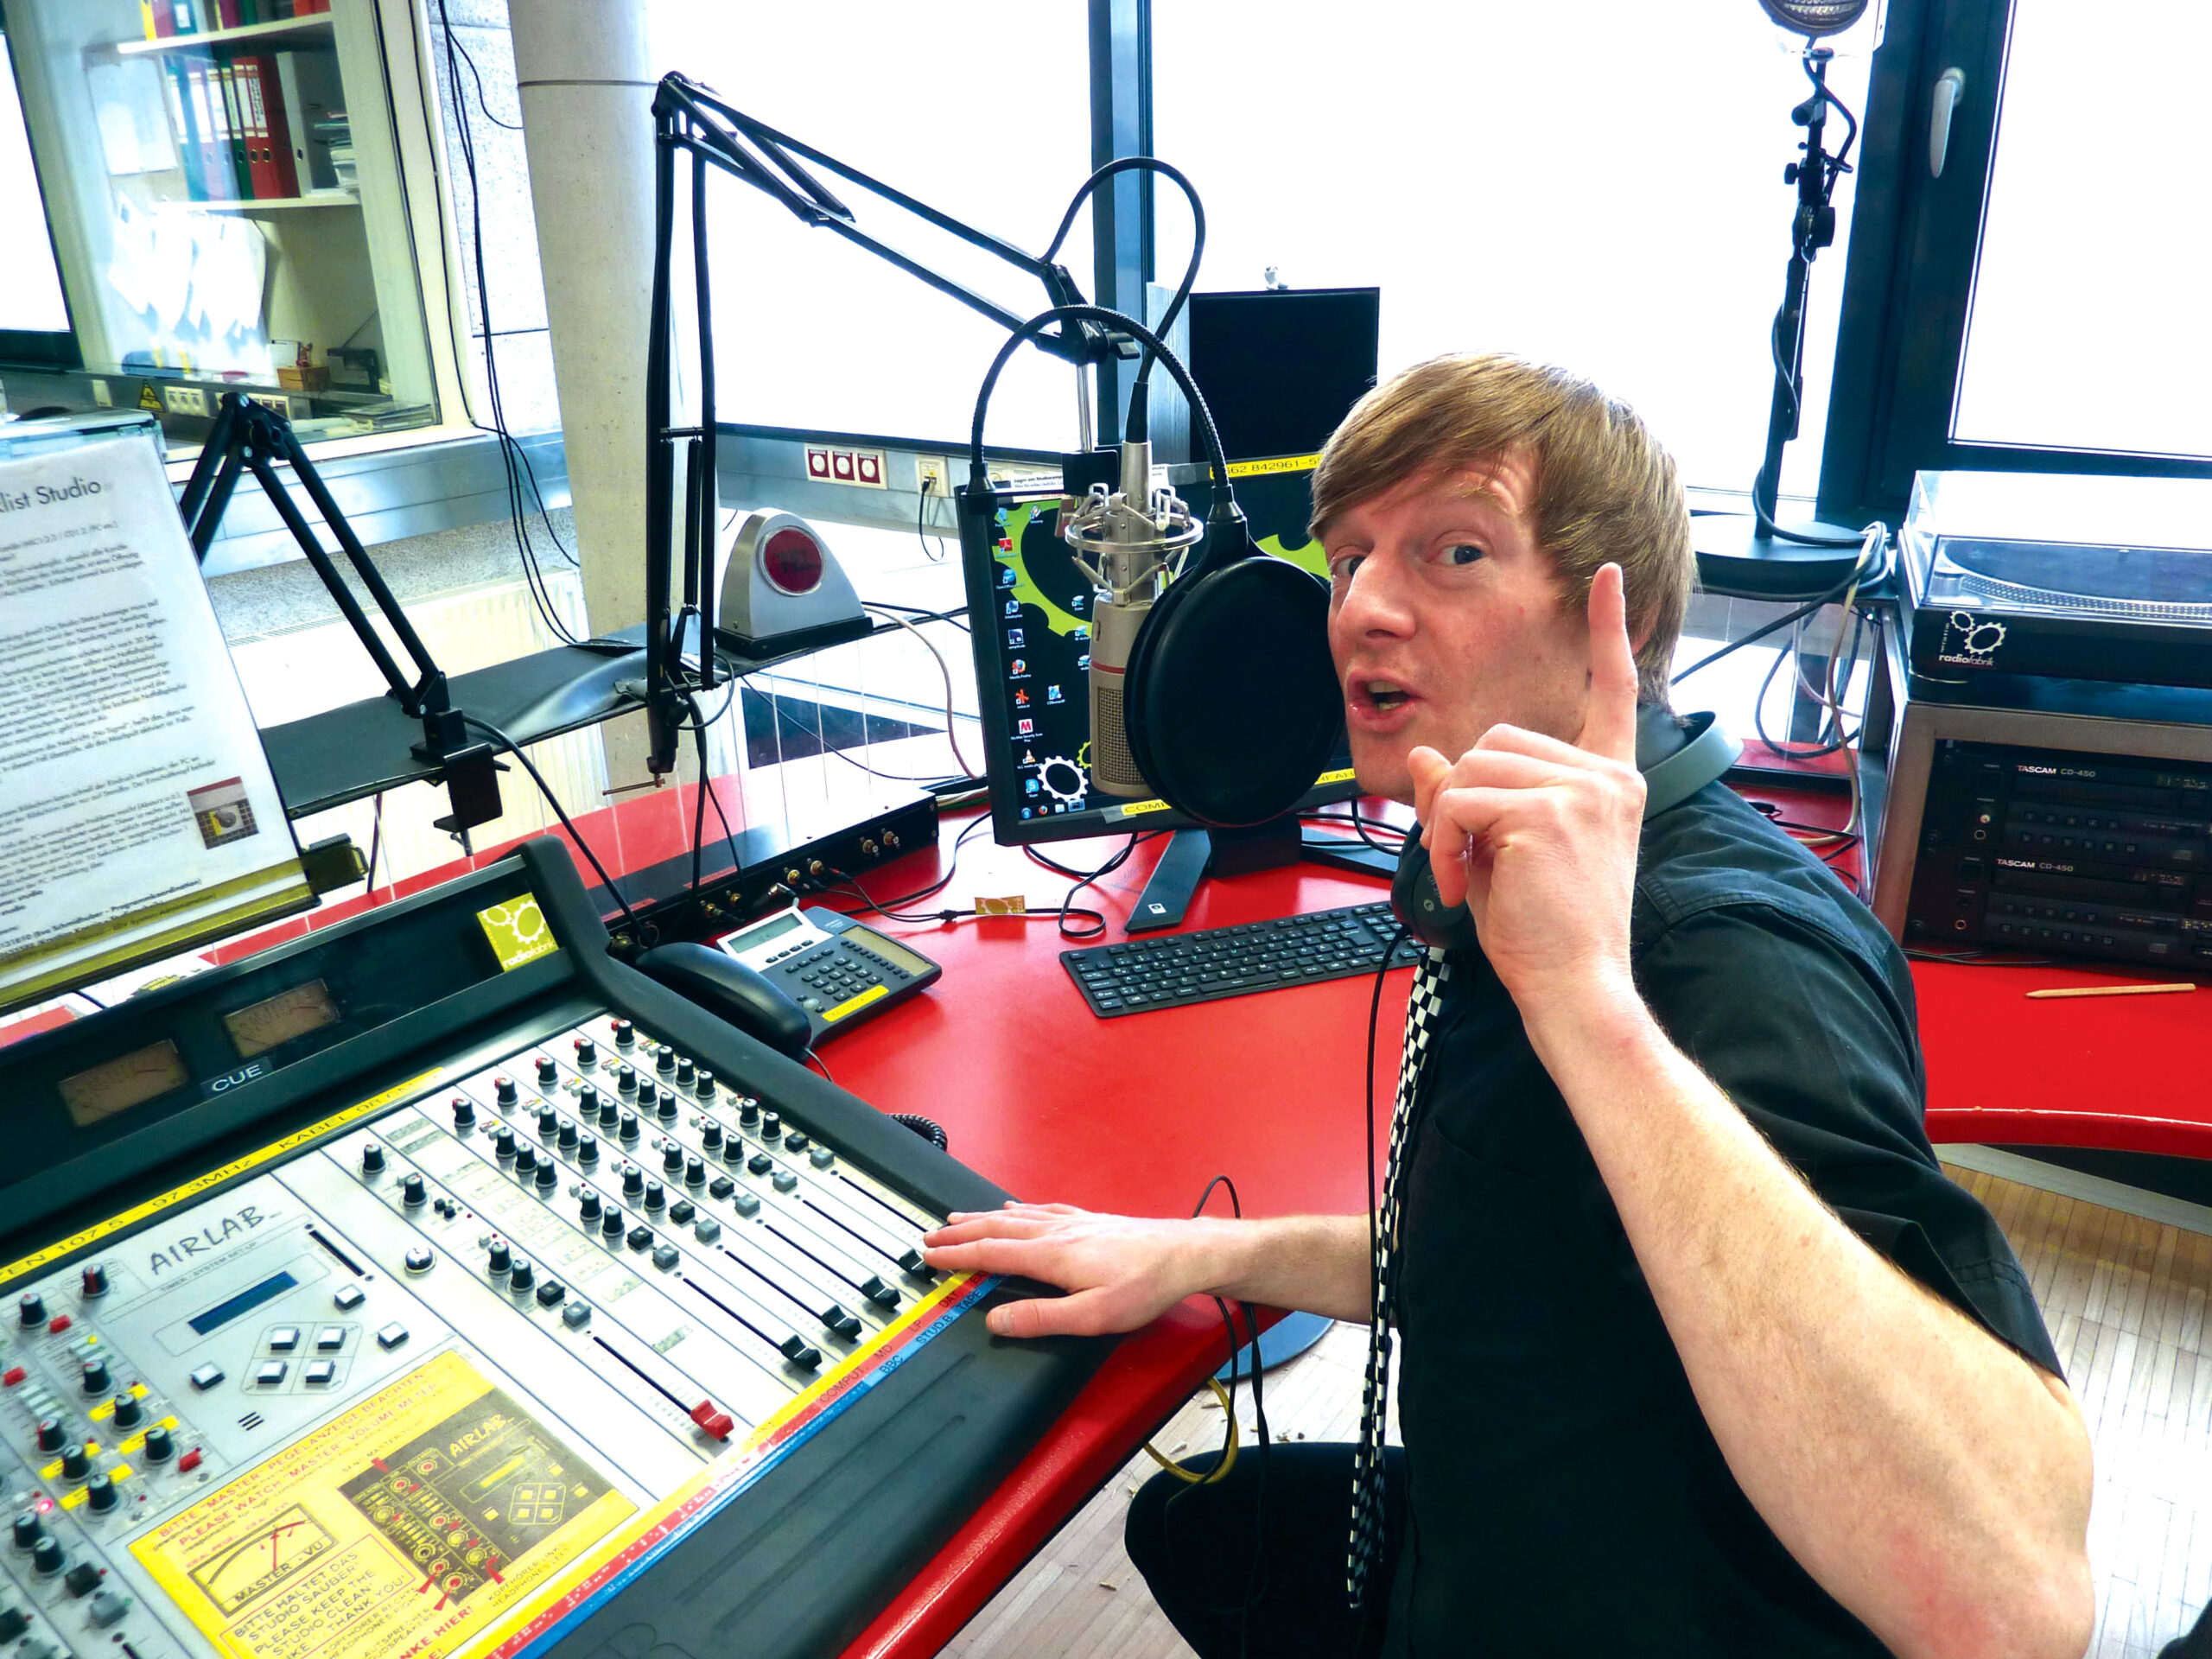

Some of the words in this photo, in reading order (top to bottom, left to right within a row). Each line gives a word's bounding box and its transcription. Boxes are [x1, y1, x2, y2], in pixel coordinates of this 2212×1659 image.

[36, 477, 102, 505] Studio
[2016, 765, 2056, 774] TASCAM
[2060, 767, 2096, 777] CD-450
[1996, 858, 2036, 868] TASCAM
[2039, 862, 2074, 873] CD-450
[212, 1063, 264, 1093] CUE
[279, 1116, 346, 1149] KABEL
[150, 1205, 264, 1276] AIRLAB
[938, 1291, 959, 1309] DAT
[956, 1288, 982, 1310] TAPE
[907, 1319, 923, 1334] LP
[874, 1344, 894, 1361] MD
[879, 1354, 904, 1375] BBC
[448, 1413, 510, 1459] AIRLAB
[159, 1509, 196, 1538] BITTE
[267, 1407, 359, 1471] PEGELANZEIGE
[179, 1510, 233, 1547] PLEASE
[233, 1481, 283, 1513] WATCH
[349, 1409, 397, 1441] VOLUME
[233, 1561, 294, 1604] MASTER
[302, 1541, 325, 1556] VU
[233, 1607, 276, 1638] BITTE
[275, 1571, 327, 1610] HALTET
[329, 1551, 359, 1573] DAS
[248, 1604, 301, 1642] STUDIO
[253, 1614, 310, 1655] PLEASE
[310, 1586, 346, 1616] KEEP
[347, 1568, 376, 1588] THE
[326, 1598, 374, 1632] THANK
[433, 1605, 474, 1637] HIER!
[272, 1618, 325, 1656] STUDIO
